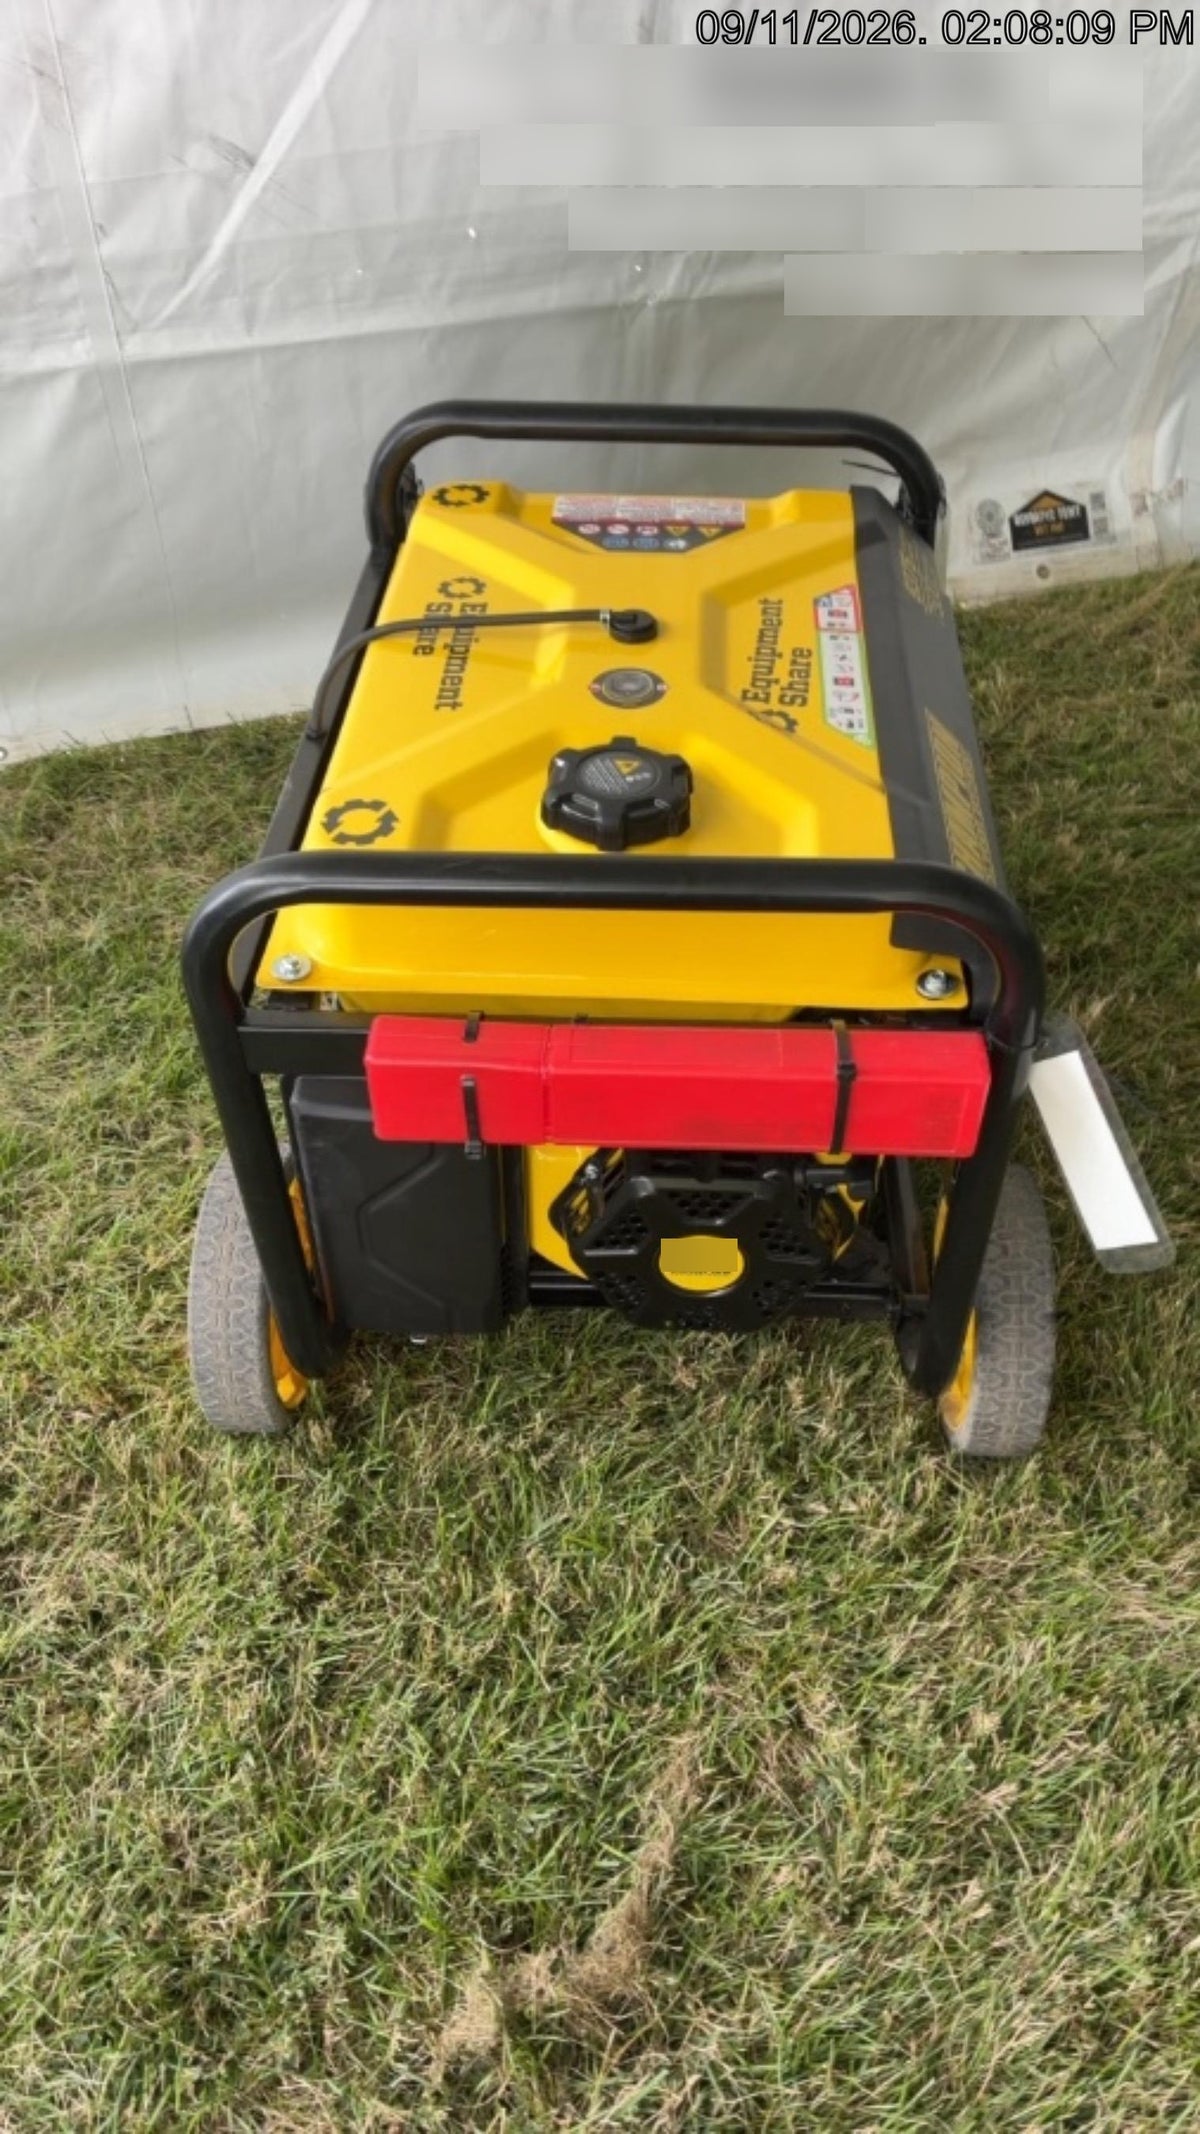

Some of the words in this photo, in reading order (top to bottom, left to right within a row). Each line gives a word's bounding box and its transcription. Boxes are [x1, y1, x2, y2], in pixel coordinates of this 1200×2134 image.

[435, 602, 488, 712] Euipment
[740, 597, 784, 705] Equipment
[778, 647, 813, 707] Share
